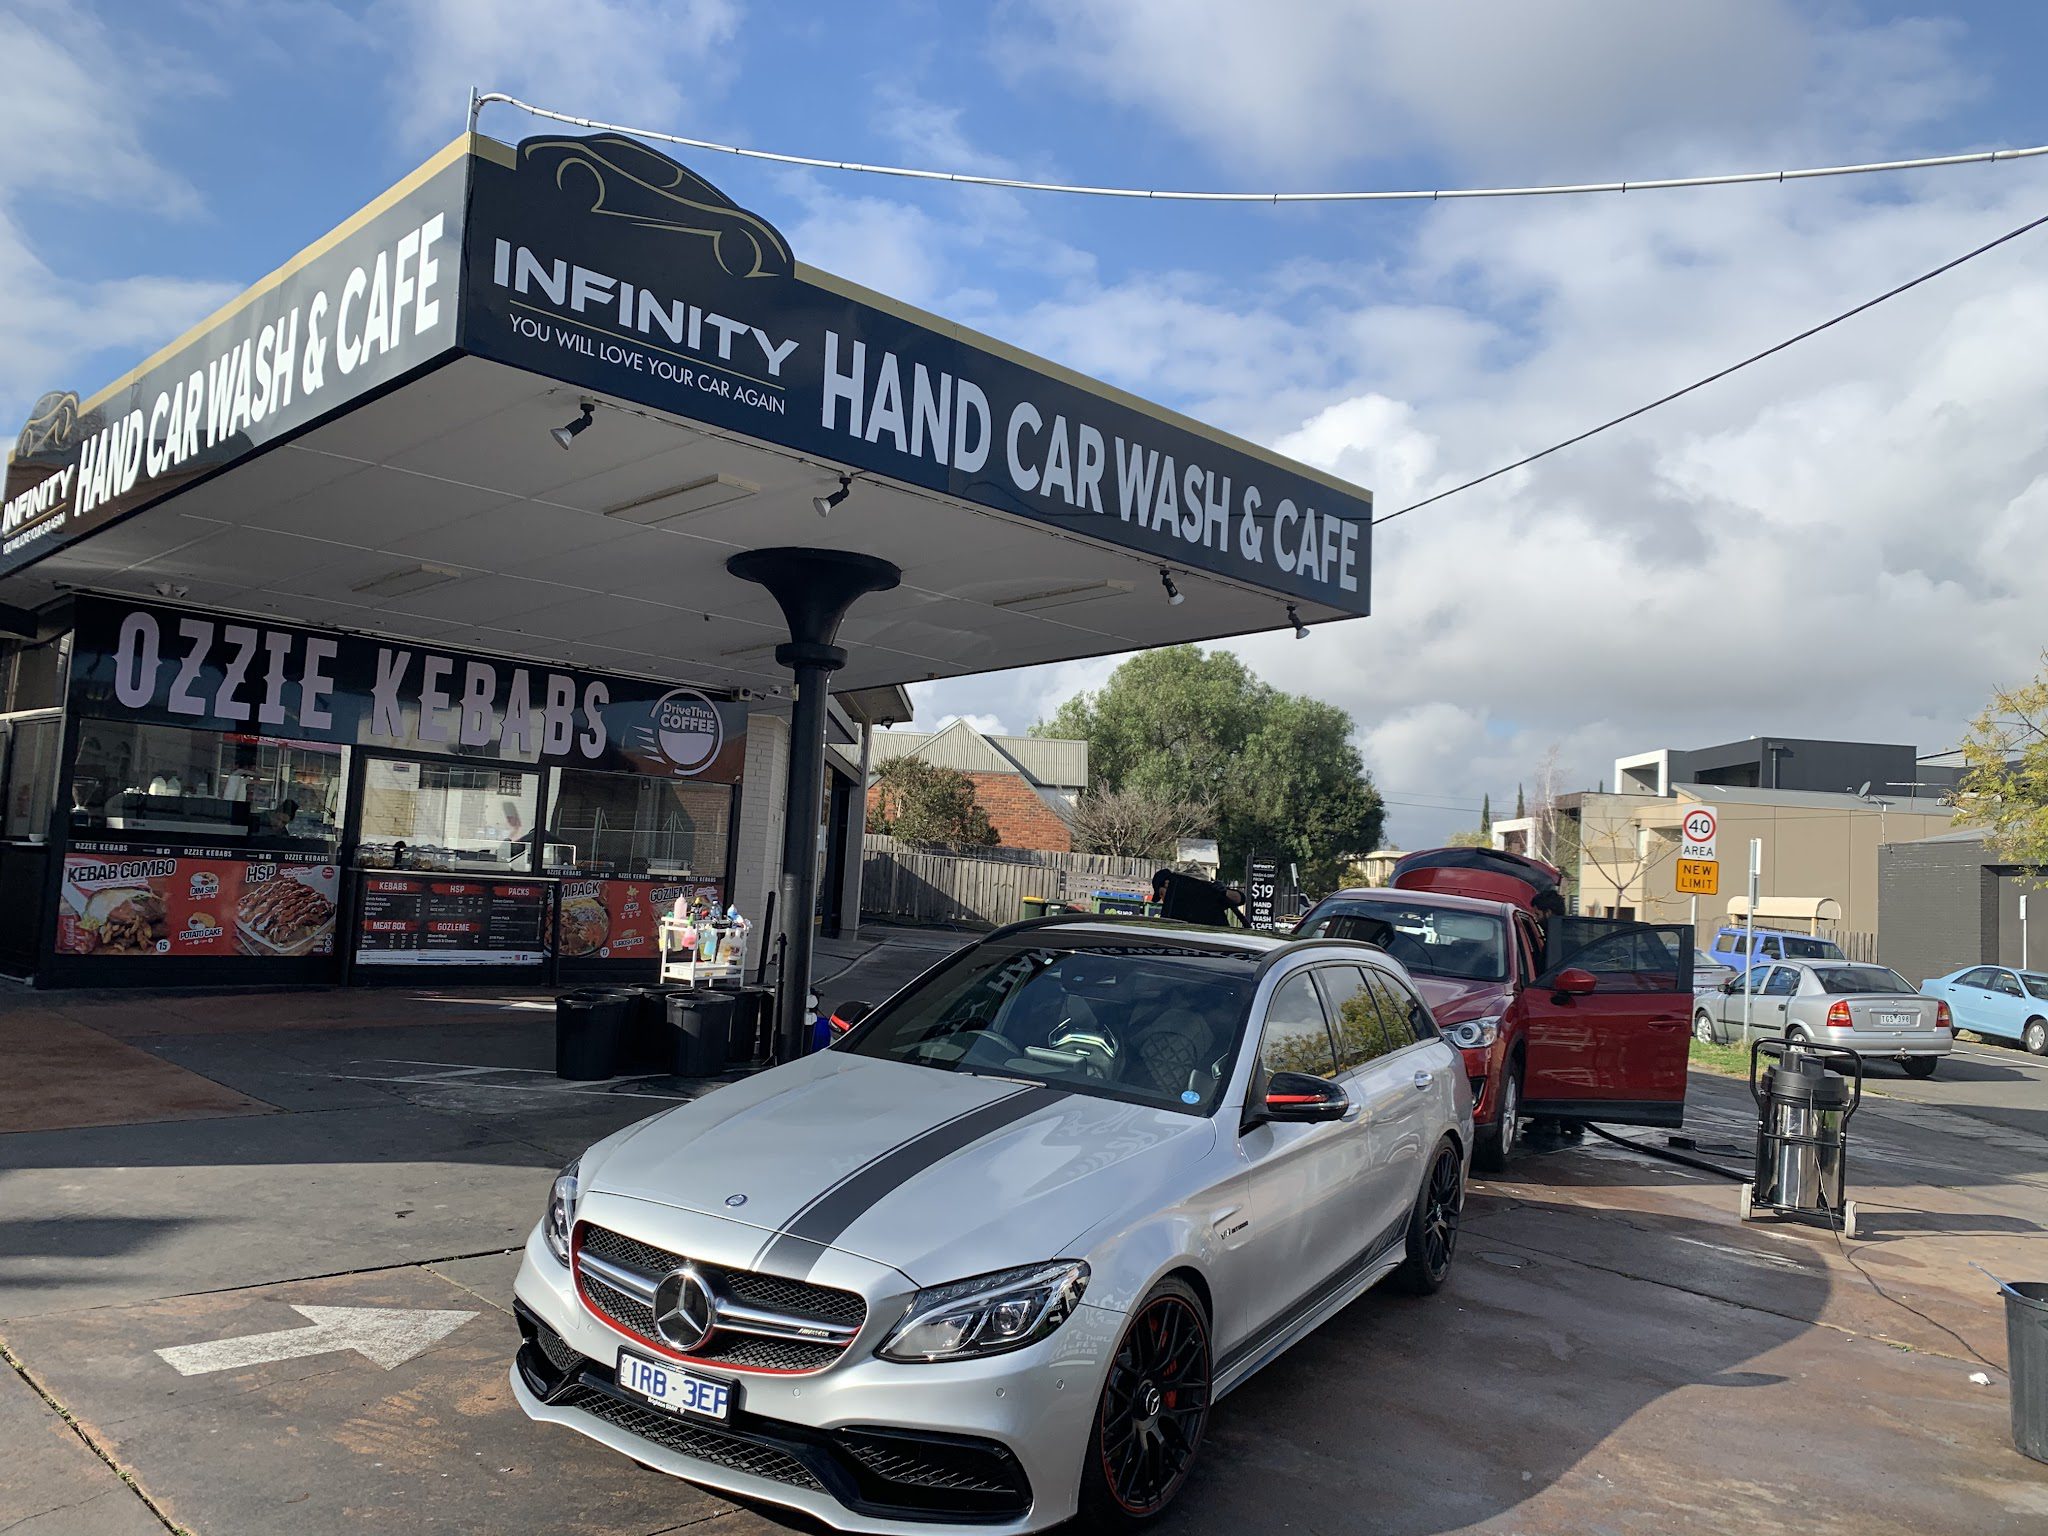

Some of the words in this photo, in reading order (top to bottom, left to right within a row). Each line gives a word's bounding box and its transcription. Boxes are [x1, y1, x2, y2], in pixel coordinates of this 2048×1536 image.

[493, 237, 800, 377] INFINITY
[74, 409, 144, 517] HAND
[146, 370, 203, 478] CAR
[206, 307, 298, 447] WASH
[302, 290, 328, 395] &
[336, 211, 444, 375] CAFE
[509, 313, 550, 343] YOU
[555, 328, 595, 357] WILL
[600, 342, 643, 372] LOVE
[648, 356, 693, 387] YOUR
[697, 374, 730, 399] CAR
[733, 386, 785, 415] AGAIN
[822, 329, 992, 473] HAND
[1007, 401, 1104, 514] CAR
[1115, 436, 1231, 553] WASH
[1239, 485, 1264, 564] &
[1273, 498, 1358, 592] CAFE
[2, 463, 75, 535] INFINITY
[111, 611, 338, 730] OZZIE
[370, 648, 610, 759] KEBABS
[660, 713, 715, 733] COFFEE
[1688, 819, 1710, 833] 40
[75, 842, 96, 850] OZZIE
[99, 843, 128, 852] KEBABS
[1683, 846, 1714, 856] AREA
[184, 848, 204, 856] OZZIE
[206, 850, 232, 858] KEBABS
[284, 853, 302, 861] OZZIE
[304, 854, 328, 862] KEBABS
[67, 864, 118, 882] KEBAB
[120, 859, 176, 879] COMBO
[246, 865, 276, 882] HSP
[1683, 864, 1712, 875] NEW
[378, 882, 408, 890] KEBABS
[1681, 877, 1713, 889] LIMIT
[450, 885, 465, 893] HSP
[508, 887, 530, 896] PACKS
[372, 922, 392, 930] MEAT
[392, 922, 406, 930] BOX
[437, 923, 470, 931] GOZLEME
[180, 930, 204, 939] POTATO
[158, 942, 168, 950] 15
